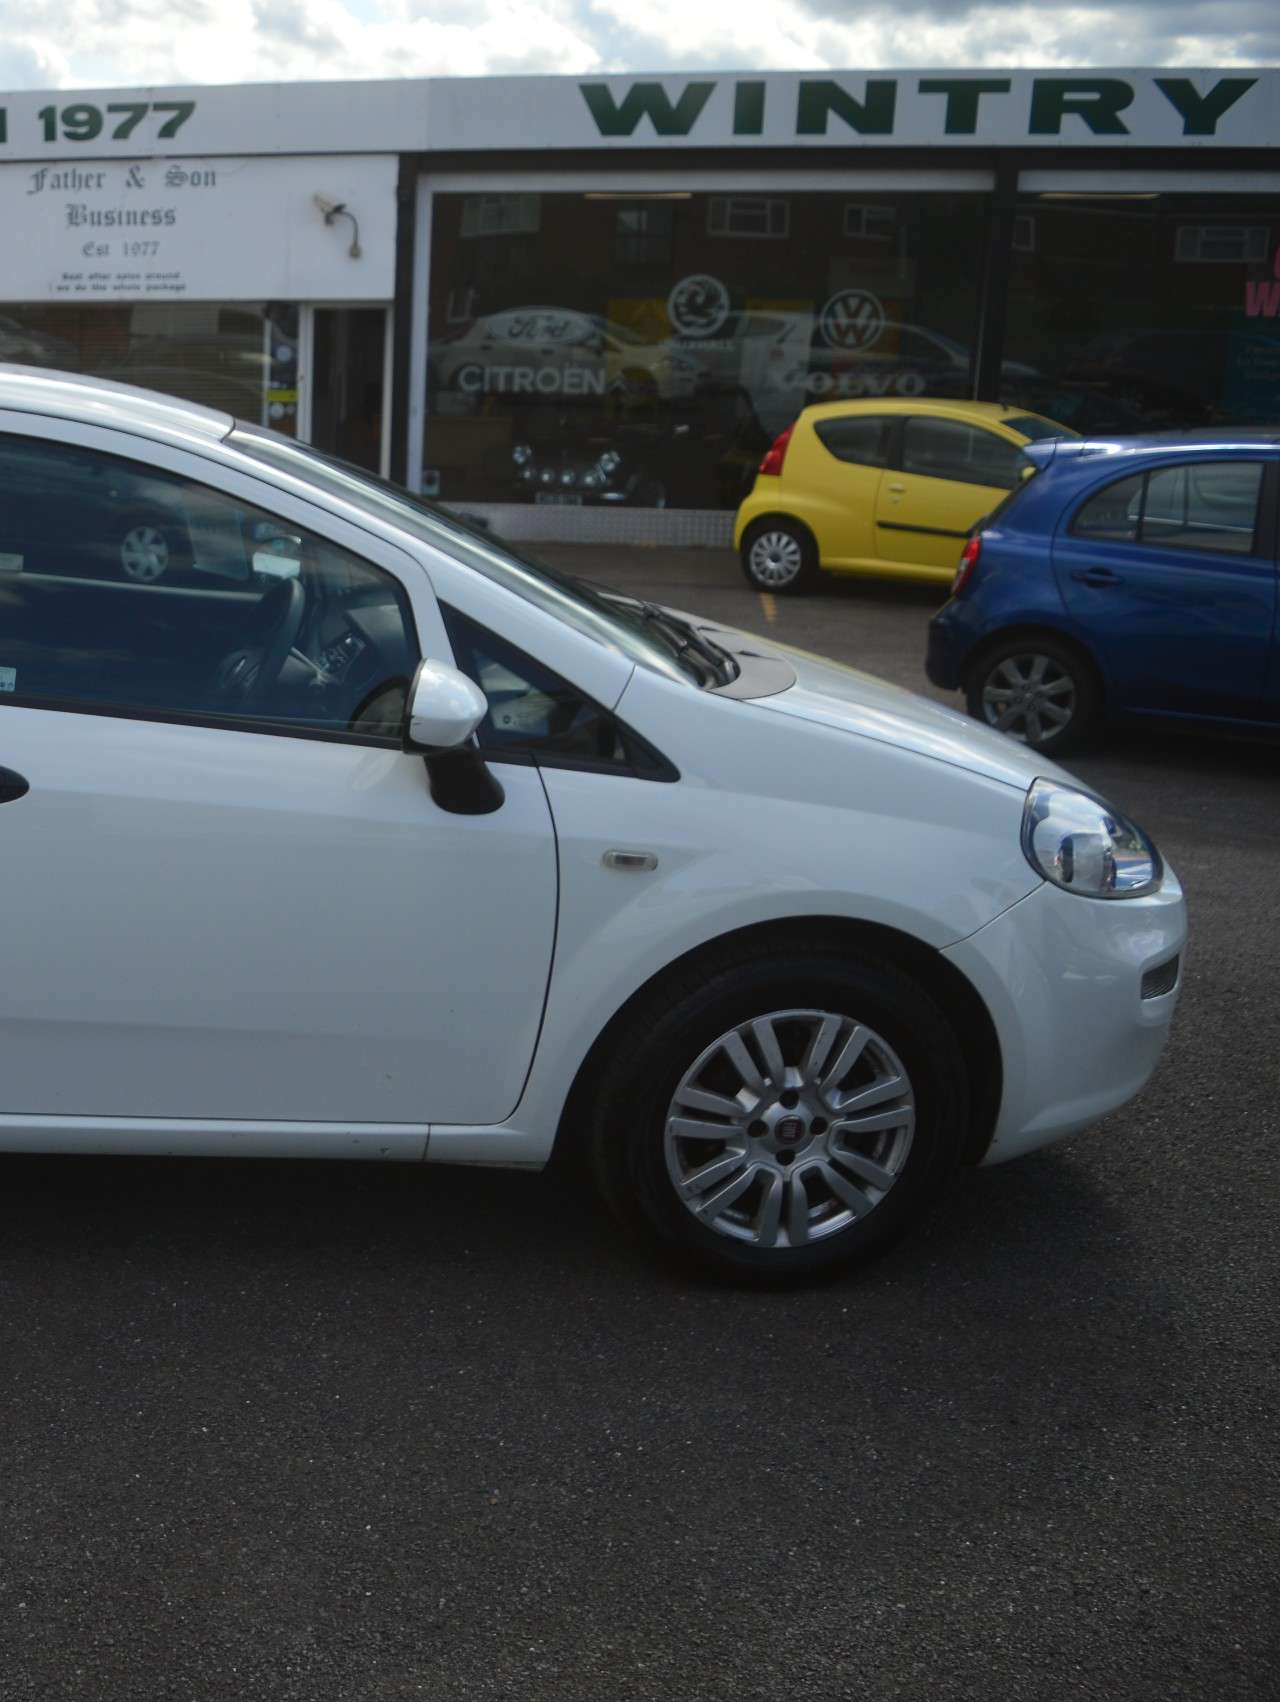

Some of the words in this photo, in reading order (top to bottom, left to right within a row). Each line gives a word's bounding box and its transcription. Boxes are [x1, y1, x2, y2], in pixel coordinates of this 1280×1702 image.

[578, 77, 1260, 136] WINTRY
[37, 101, 197, 142] 1977
[26, 167, 106, 194] Father
[125, 165, 145, 189] &
[165, 166, 217, 187] Son
[66, 203, 177, 227] Business
[773, 371, 926, 395] VOLVO
